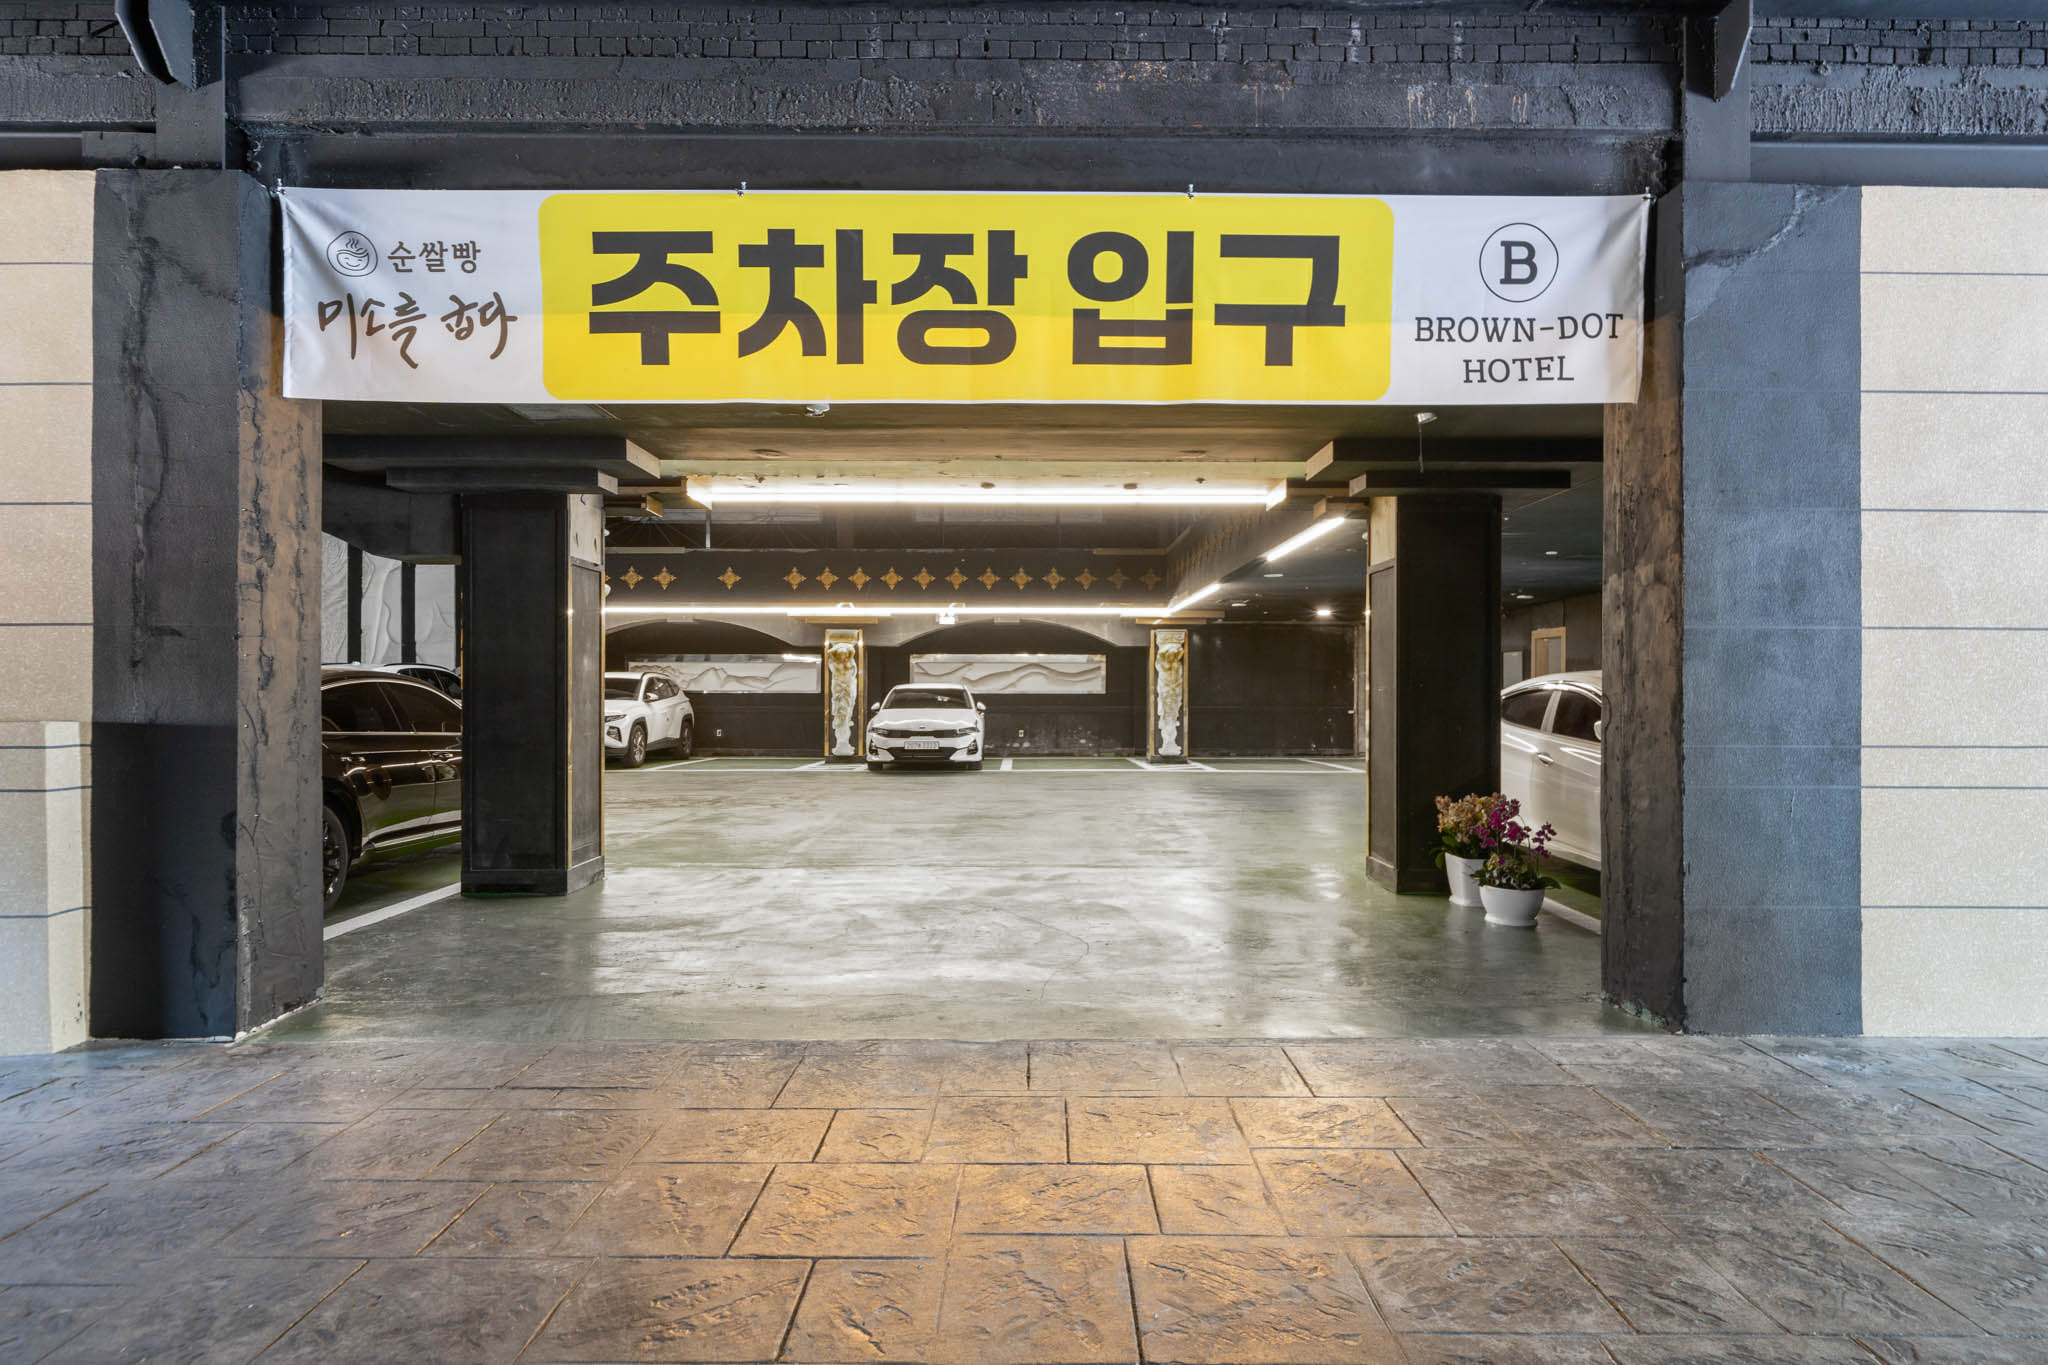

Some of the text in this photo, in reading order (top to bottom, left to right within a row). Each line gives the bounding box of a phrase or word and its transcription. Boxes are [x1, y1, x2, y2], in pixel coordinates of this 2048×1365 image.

[387, 240, 482, 274] 순쌀빵
[1499, 240, 1538, 285] B
[588, 228, 1346, 367] 주차장 입구
[317, 289, 518, 370] 미소를 굽다
[1414, 311, 1625, 343] BROWN-DOT
[1462, 355, 1575, 384] HOTEL
